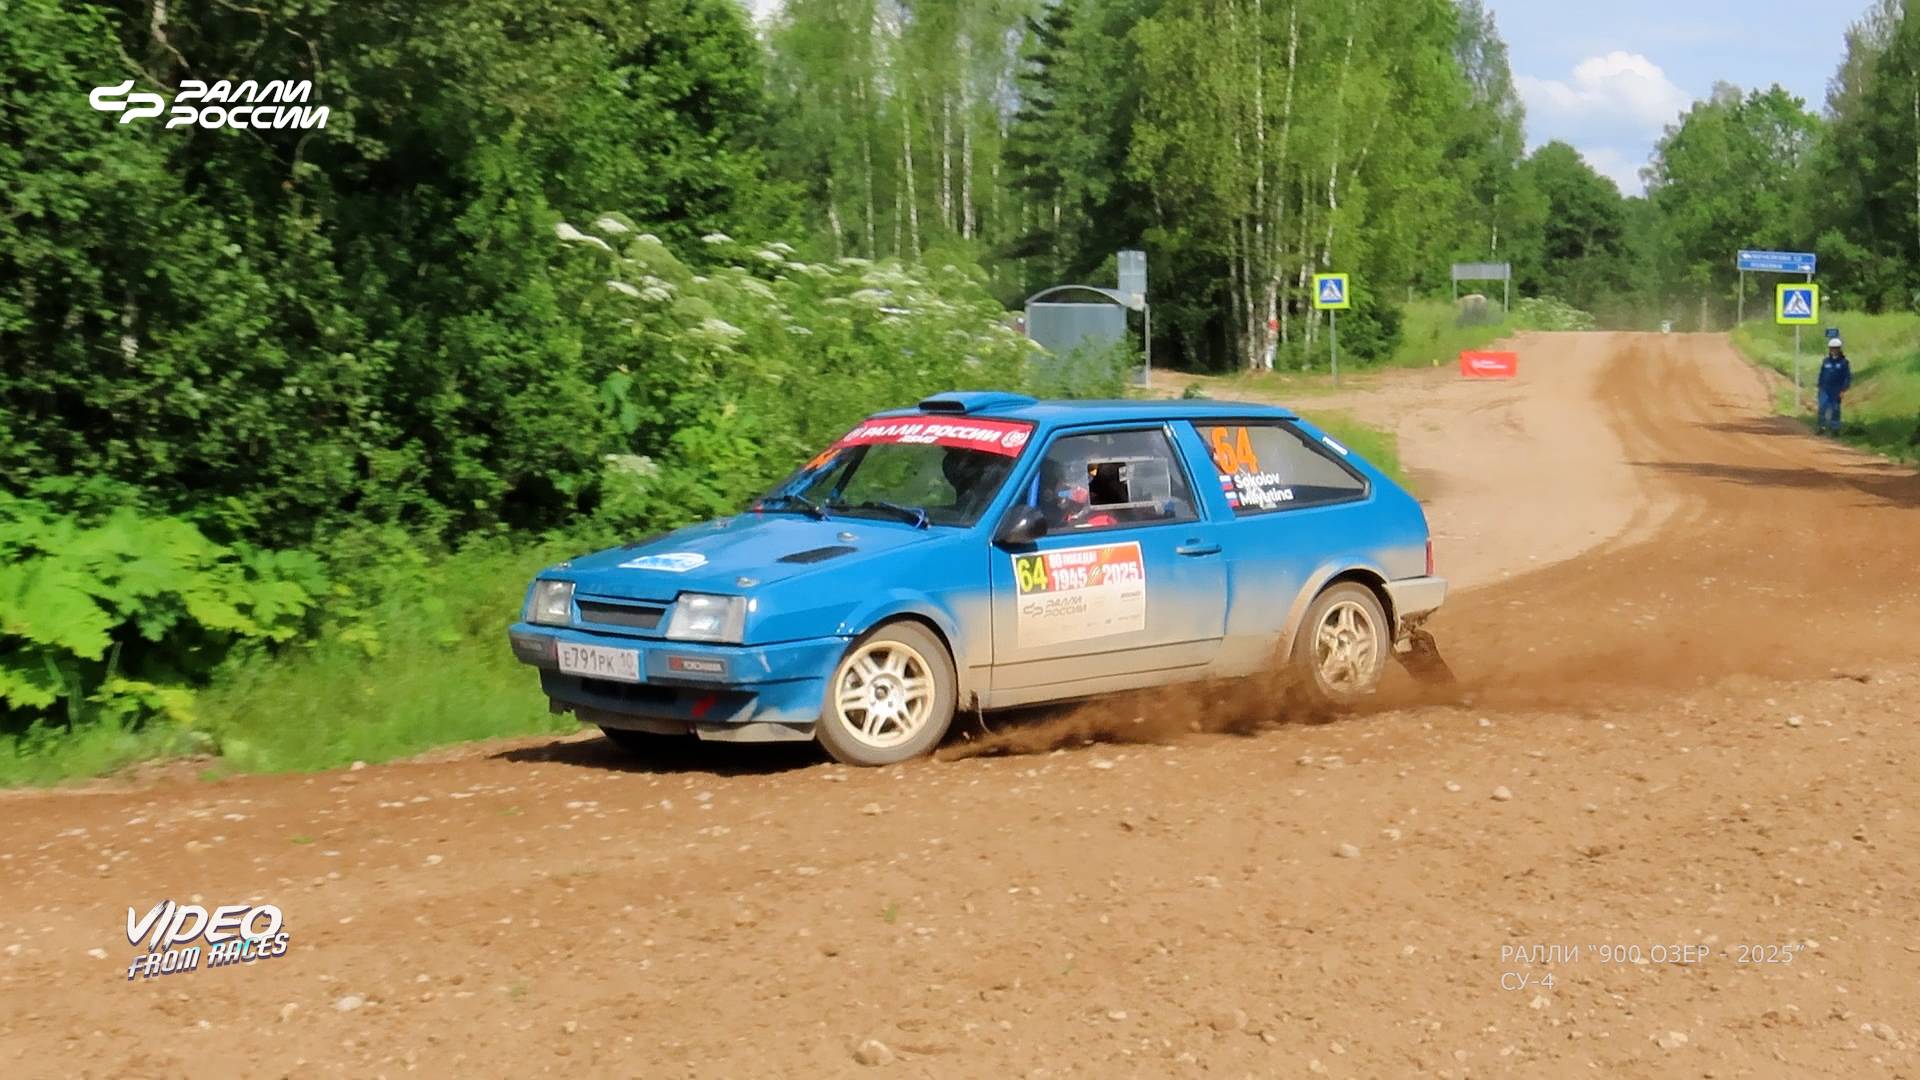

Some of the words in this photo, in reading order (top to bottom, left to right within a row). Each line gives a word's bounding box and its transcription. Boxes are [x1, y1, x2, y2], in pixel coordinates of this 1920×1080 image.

[860, 424, 920, 439] РАЛЛИ
[924, 424, 1002, 443] РОССИИ
[1211, 426, 1260, 475] 64
[1234, 470, 1280, 489] Sokolov
[1017, 556, 1049, 593] 64
[1051, 566, 1088, 591] 1945
[1101, 561, 1139, 585] 2025
